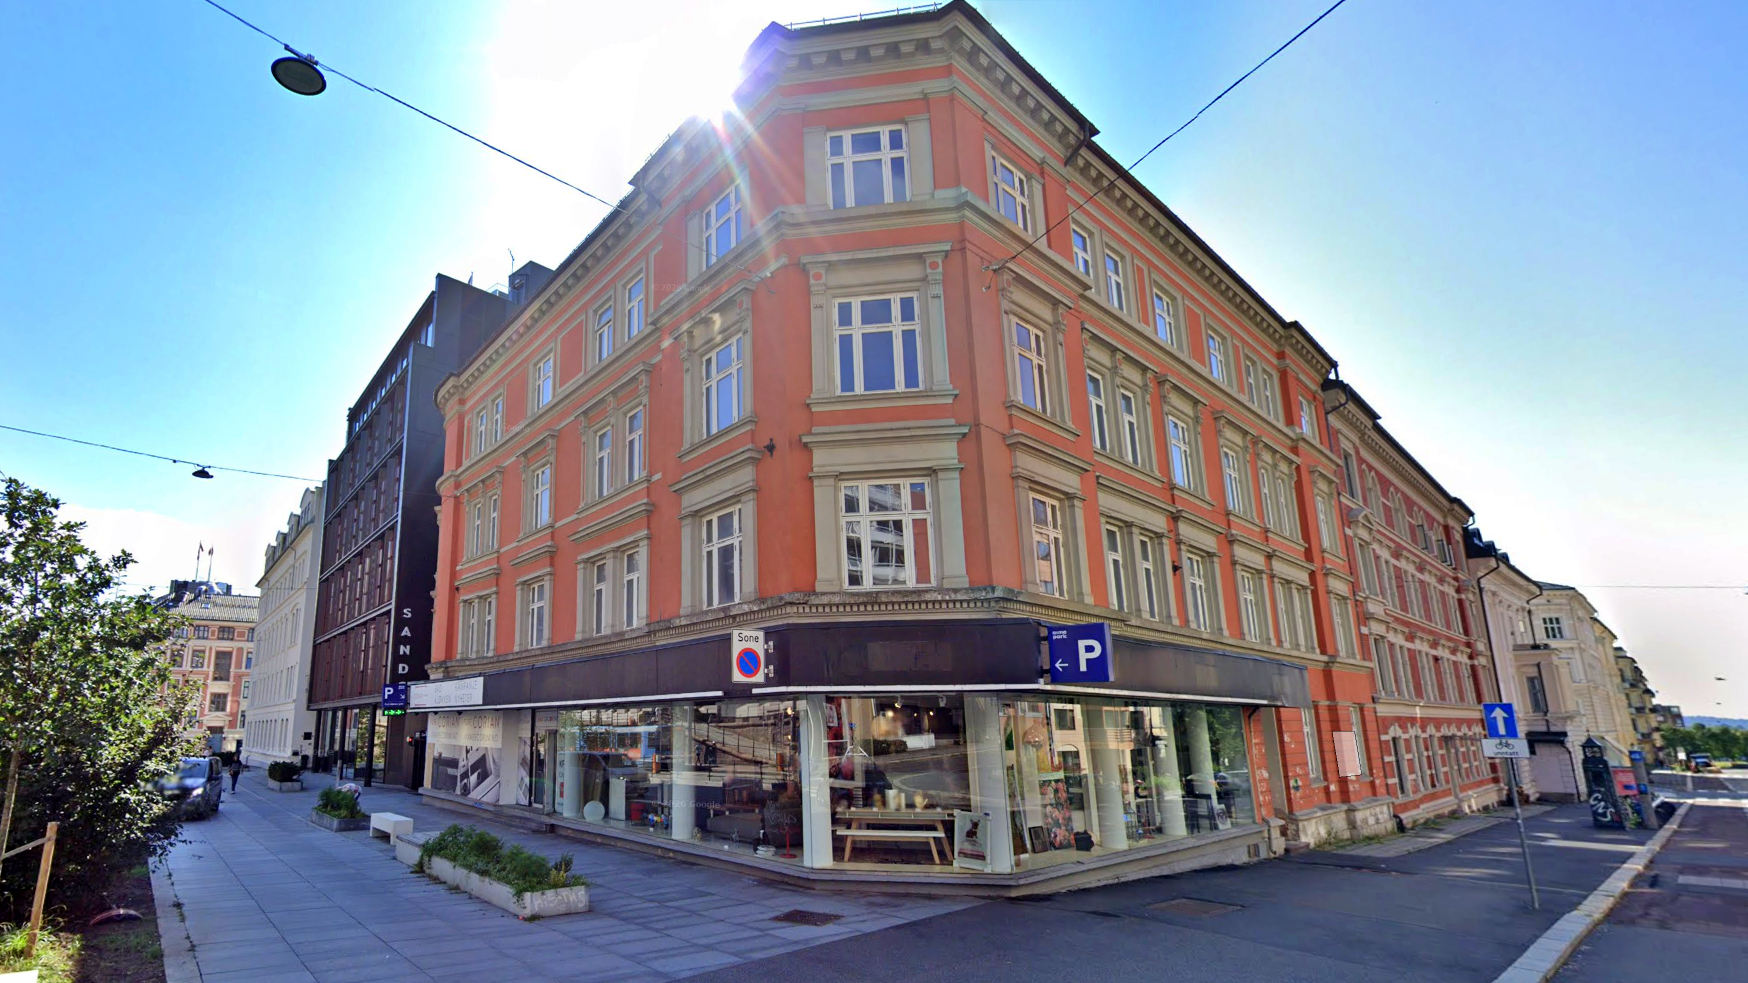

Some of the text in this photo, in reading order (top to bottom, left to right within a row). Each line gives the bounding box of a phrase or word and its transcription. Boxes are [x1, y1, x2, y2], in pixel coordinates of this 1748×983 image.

[737, 632, 759, 643] Sone
[1077, 639, 1102, 672] P
[384, 687, 394, 699] P
